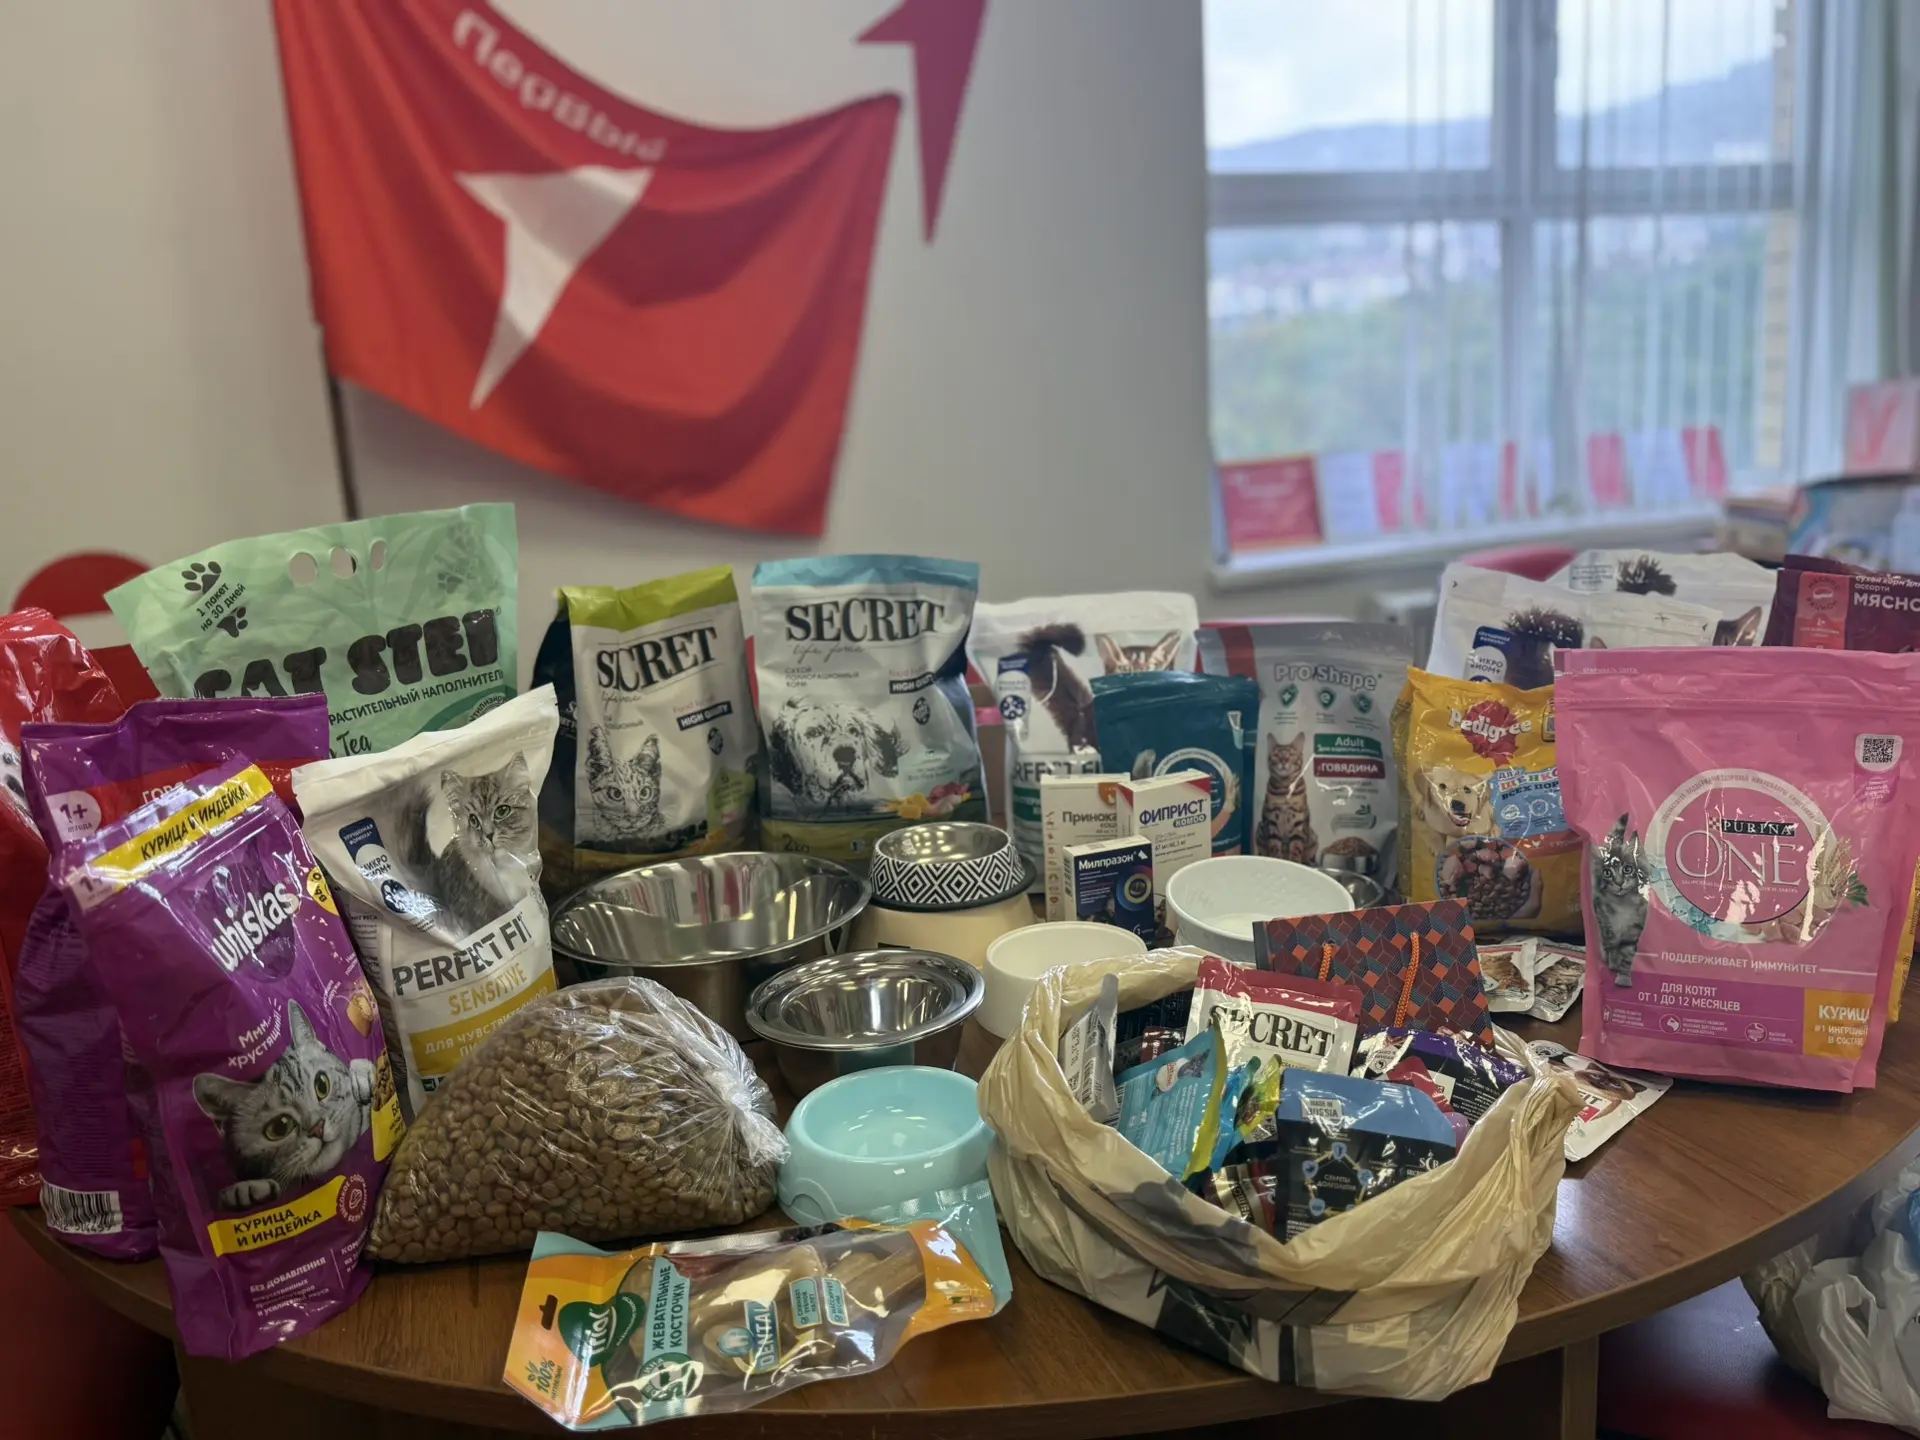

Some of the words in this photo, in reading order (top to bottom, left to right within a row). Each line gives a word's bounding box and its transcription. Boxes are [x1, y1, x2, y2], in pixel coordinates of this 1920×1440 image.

[196, 608, 206, 617] 1
[204, 583, 229, 610] пакет
[1854, 582, 1890, 592] ассорти
[200, 618, 213, 632] на
[212, 604, 224, 618] 30
[224, 583, 246, 608] дней
[1853, 592, 1920, 612] МЯСНО
[786, 598, 946, 643] SECRET
[596, 626, 719, 692] SCRET
[1473, 656, 1504, 668] ИКРО
[328, 688, 420, 726] РАСТИТЕЛЬНЫЙ
[422, 670, 504, 700] НАПОЛНИТЕЛ
[892, 682, 915, 692] HIGH
[681, 713, 704, 728] HIGH
[1448, 708, 1534, 744] Pedigree
[336, 730, 372, 757] Tea
[1334, 736, 1364, 747] Adult
[1321, 762, 1378, 772] ГОВЯДИНА
[1502, 783, 1532, 800] ВСЕХ
[1534, 781, 1559, 790] ПОР
[60, 802, 88, 824] 1+
[140, 822, 188, 861] КУРИЦА
[187, 812, 196, 830] И
[198, 786, 248, 824] ИНДЕЙКА
[1062, 811, 1117, 826] Принока
[1139, 799, 1204, 826] ФИПРИСТ
[1723, 820, 1793, 836] PURINA
[366, 864, 392, 877] ИОМ+
[1078, 852, 1134, 871] Милпразон
[1676, 830, 1802, 886] ONE
[211, 882, 295, 973] whiskas
[393, 932, 504, 996] PERFECT
[1660, 954, 1747, 970] ПОДДЕРЖИВАЕТ
[1751, 958, 1818, 975] ИММУНИТЕТ
[448, 962, 528, 1016] SENSITIVE
[1638, 992, 1651, 1002] ОТ
[1653, 993, 1658, 1003] 1
[1660, 994, 1676, 1006] ДО
[1678, 995, 1690, 1006] 12
[1692, 997, 1741, 1013] МЕСЯЦЕВ
[1660, 982, 1683, 994] ДЛЯ
[1686, 984, 1718, 998] КОТЯТ
[228, 1009, 283, 1070] хрустящий!
[238, 1016, 272, 1050] Ммм...
[1211, 1005, 1335, 1057] SECRET
[425, 1040, 454, 1055] ДЛЯ
[1324, 1174, 1352, 1182] СЕКРЕТЫ
[232, 1208, 295, 1235] КУРИЦА
[237, 1234, 249, 1247] И
[252, 1210, 322, 1245] ИНДЕЙКА
[250, 1285, 265, 1293] БЕЗ
[266, 1257, 326, 1290] ДОБАВЛЕНИЯ
[652, 1264, 671, 1352] ЖЕВАТЕЛЬНЫЕ
[669, 1282, 686, 1349] КОСТОЧКИ
[754, 1306, 775, 1366] DENTAL
[536, 1358, 556, 1393] 100%
